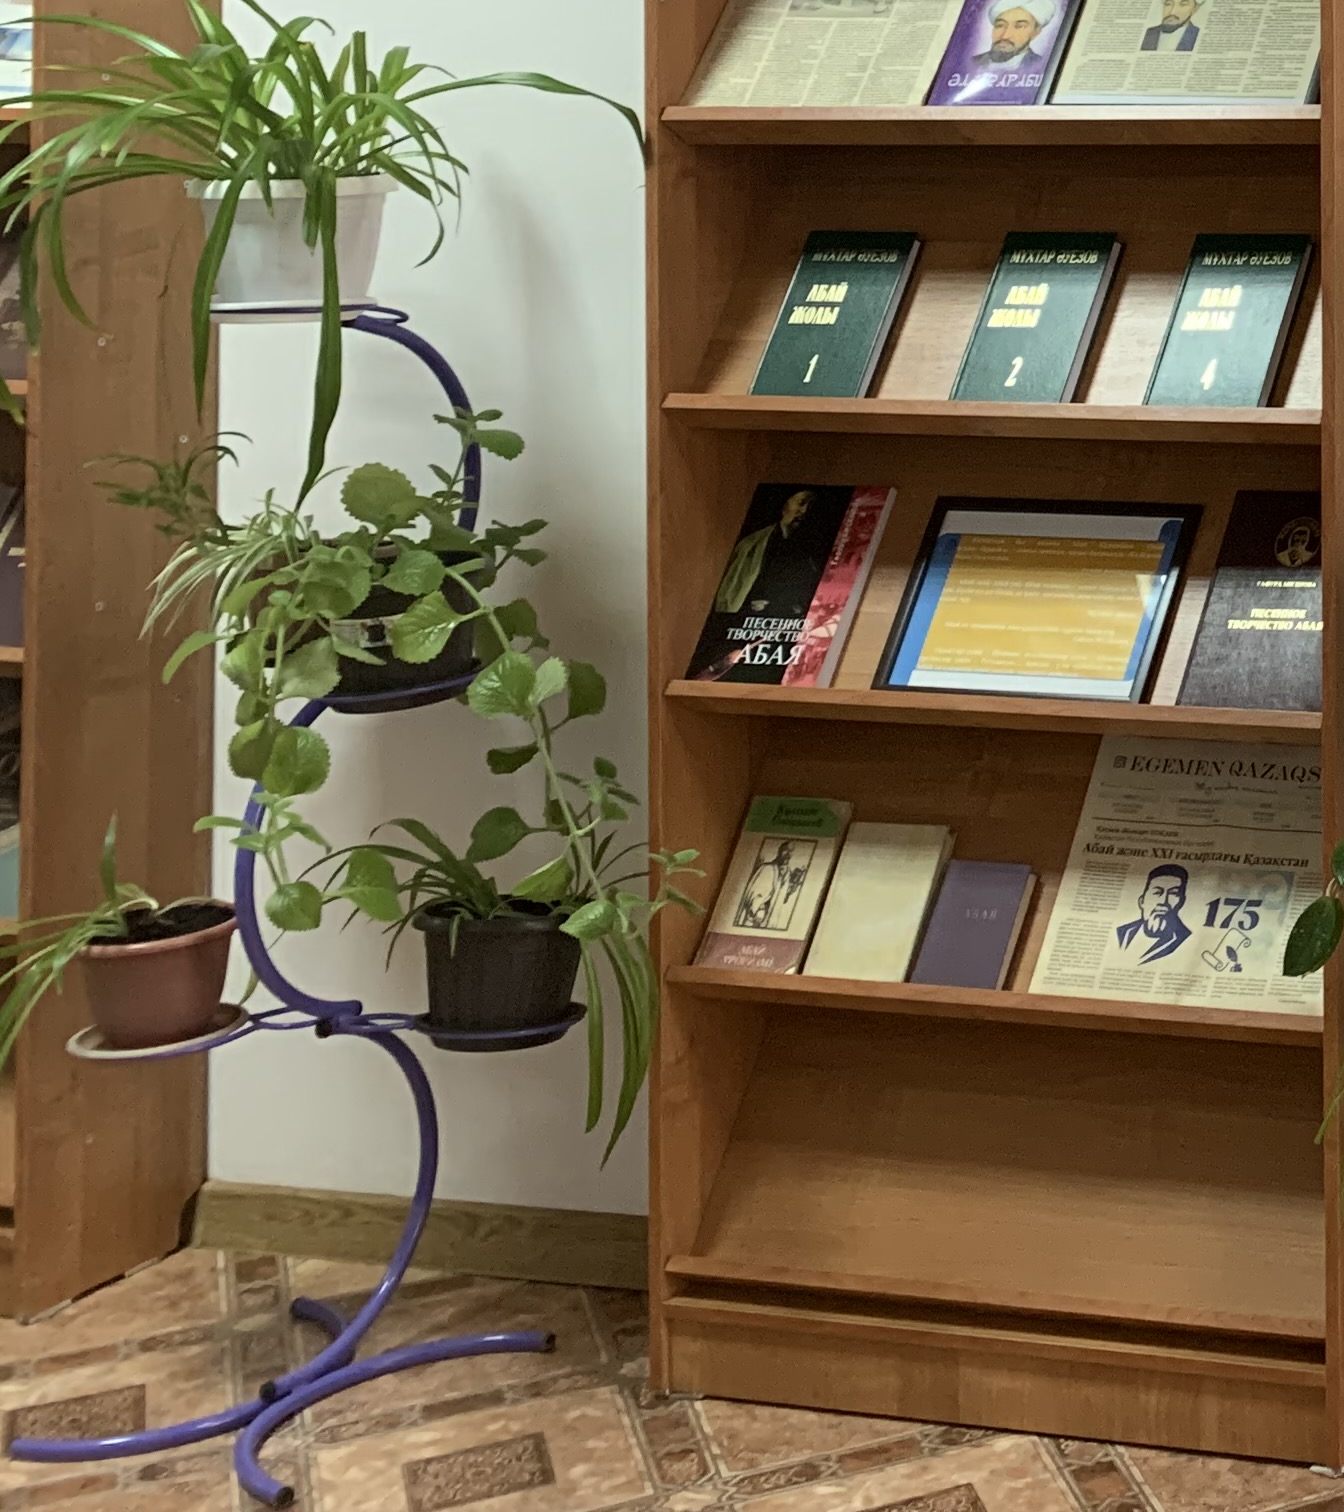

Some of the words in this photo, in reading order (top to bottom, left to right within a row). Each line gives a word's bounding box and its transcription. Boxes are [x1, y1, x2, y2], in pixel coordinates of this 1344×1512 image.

[805, 281, 849, 302] АБАЙ
[1004, 283, 1050, 305] АБАЙ
[1198, 284, 1243, 308] АБАЙ
[787, 306, 840, 325] ЖОЛЫ
[986, 308, 1042, 328] ЖОЛЫ
[1180, 310, 1237, 331] ЖОЛЫ
[802, 354, 818, 384] 1
[1004, 356, 1024, 388] 2
[1199, 358, 1217, 390] 4
[742, 616, 815, 631] ПЕСЕННОЕ
[726, 628, 811, 642] ТВОРЧЕСТВО
[732, 644, 807, 666] АБАЯ
[1129, 755, 1226, 777] EGEMEN
[1082, 842, 1114, 857] Абай
[1116, 845, 1148, 858] және
[1149, 847, 1173, 859] XXI
[1243, 853, 1310, 868] Қазақстан
[1201, 896, 1265, 934] 175
